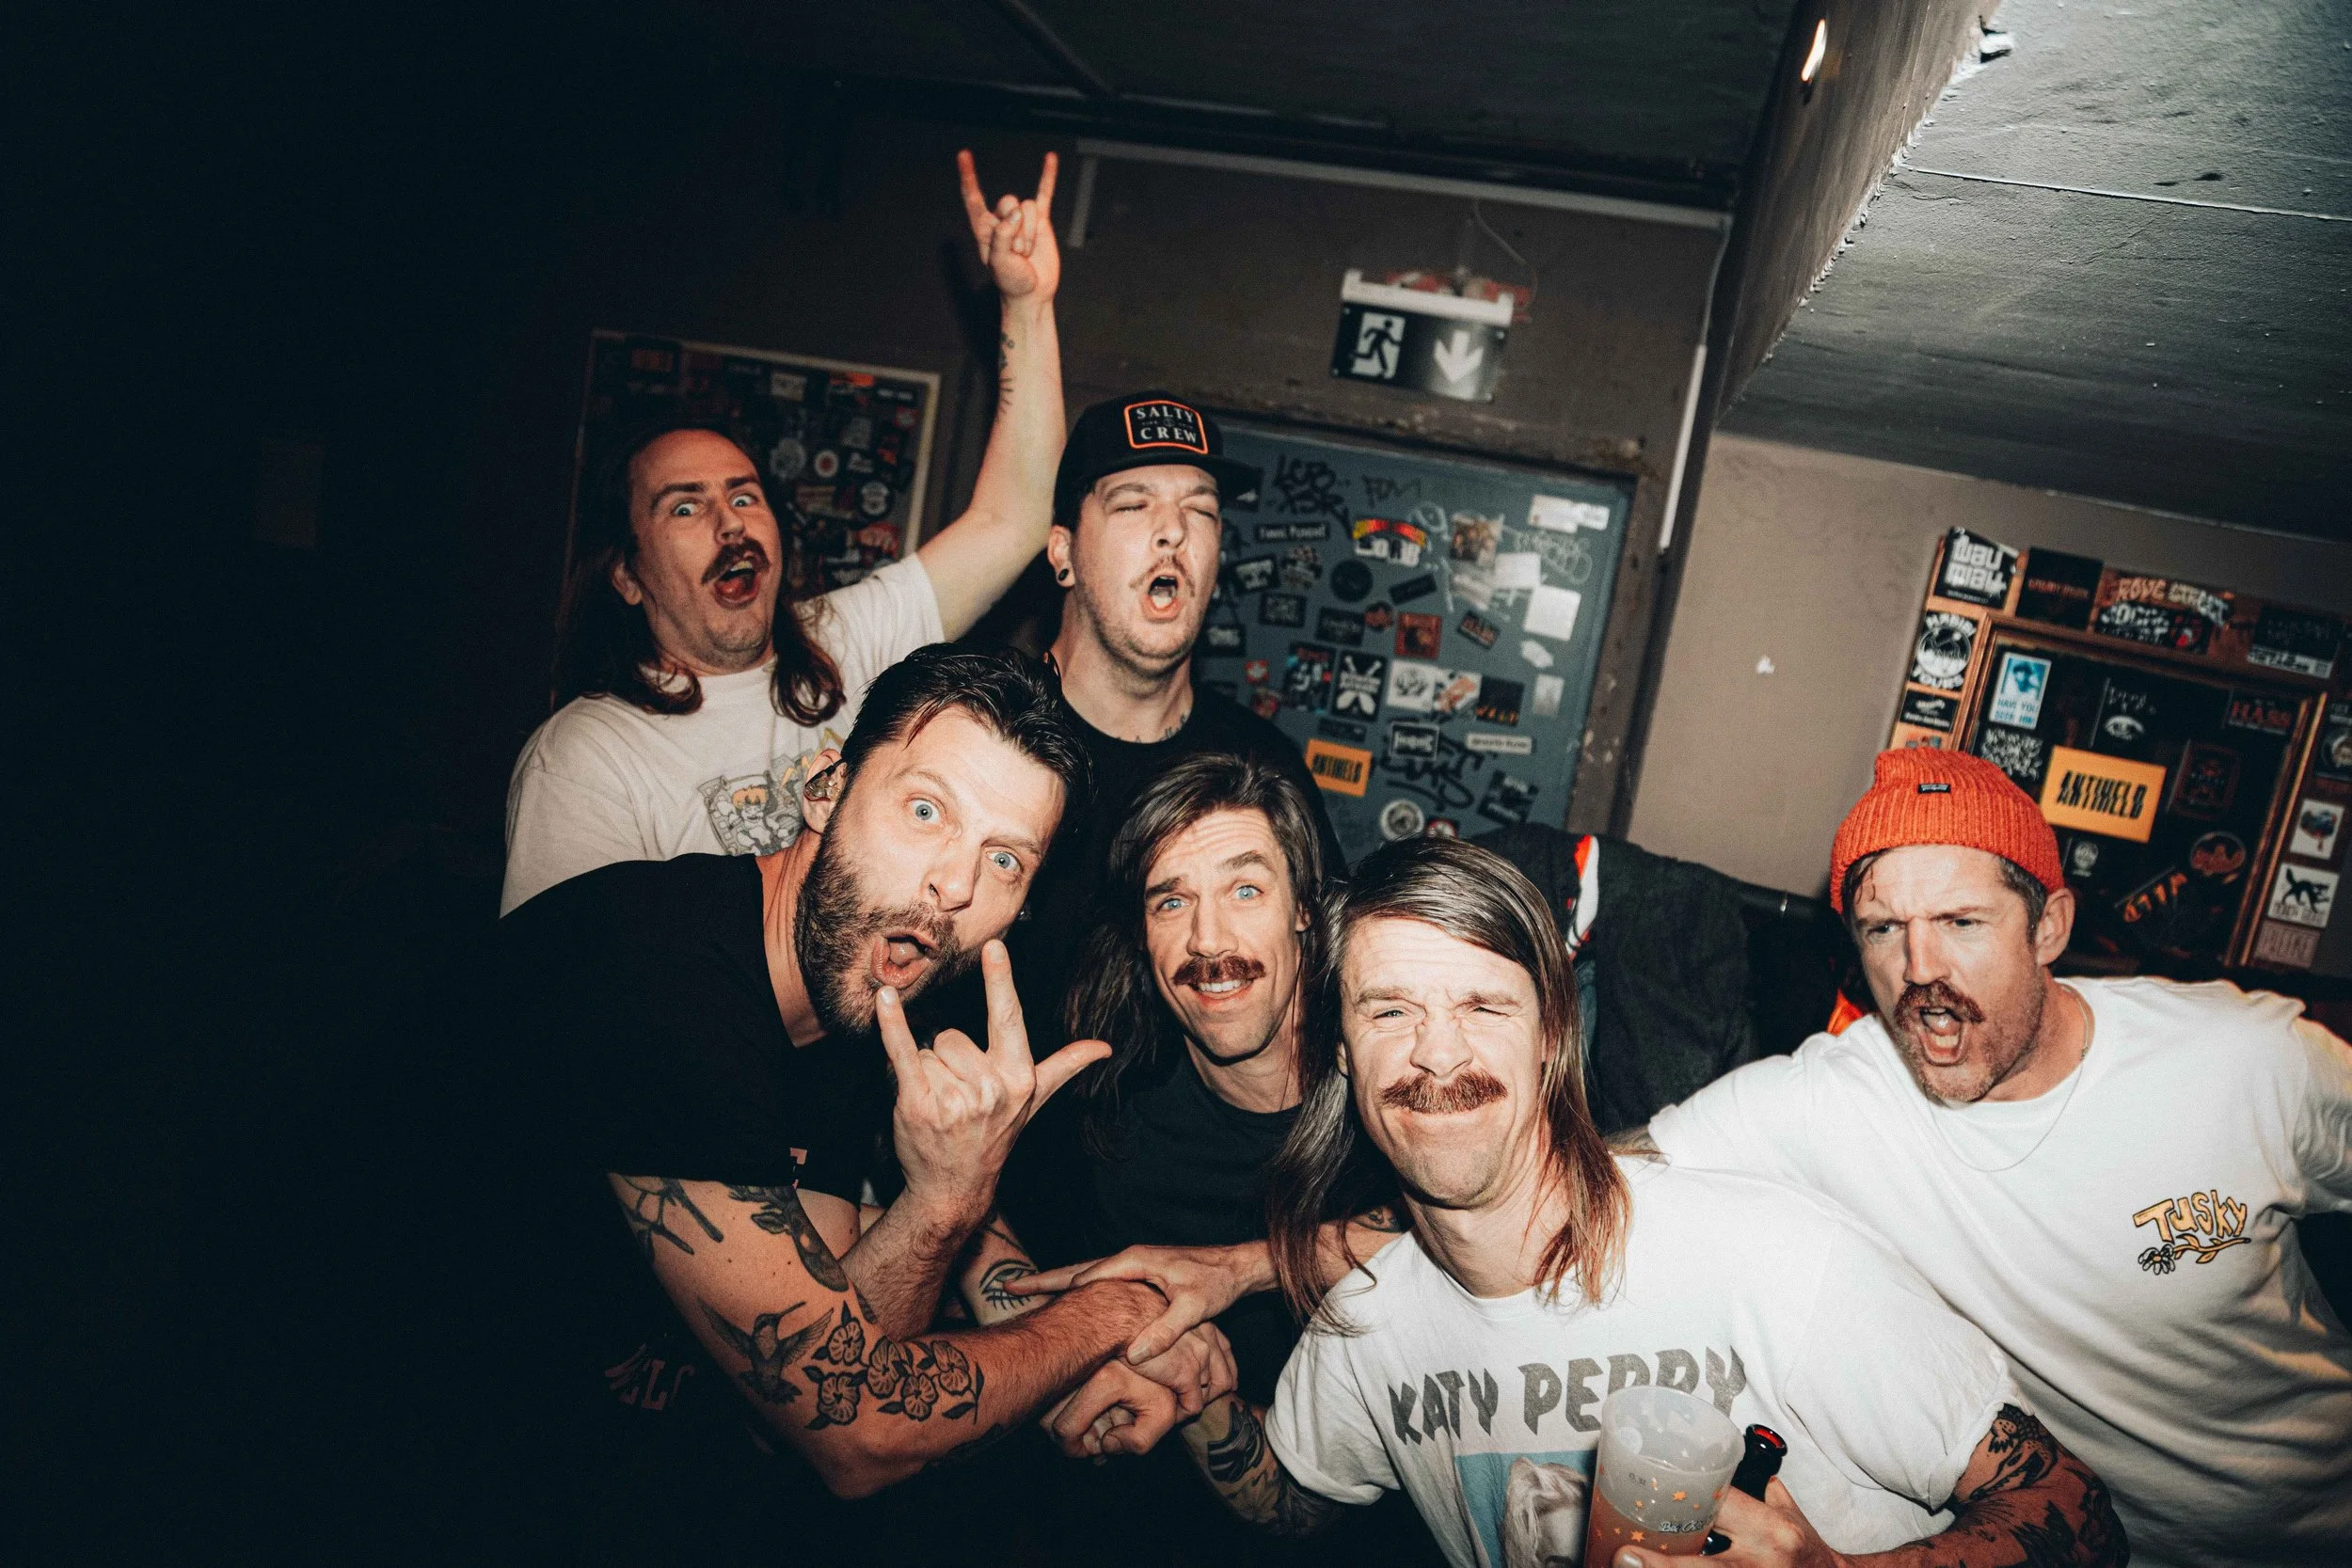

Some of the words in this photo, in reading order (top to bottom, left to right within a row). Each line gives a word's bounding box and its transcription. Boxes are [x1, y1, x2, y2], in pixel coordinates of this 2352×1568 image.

[1136, 404, 1194, 422] SALTY
[1140, 426, 1197, 443] CREW
[1388, 1368, 1499, 1446] KATY
